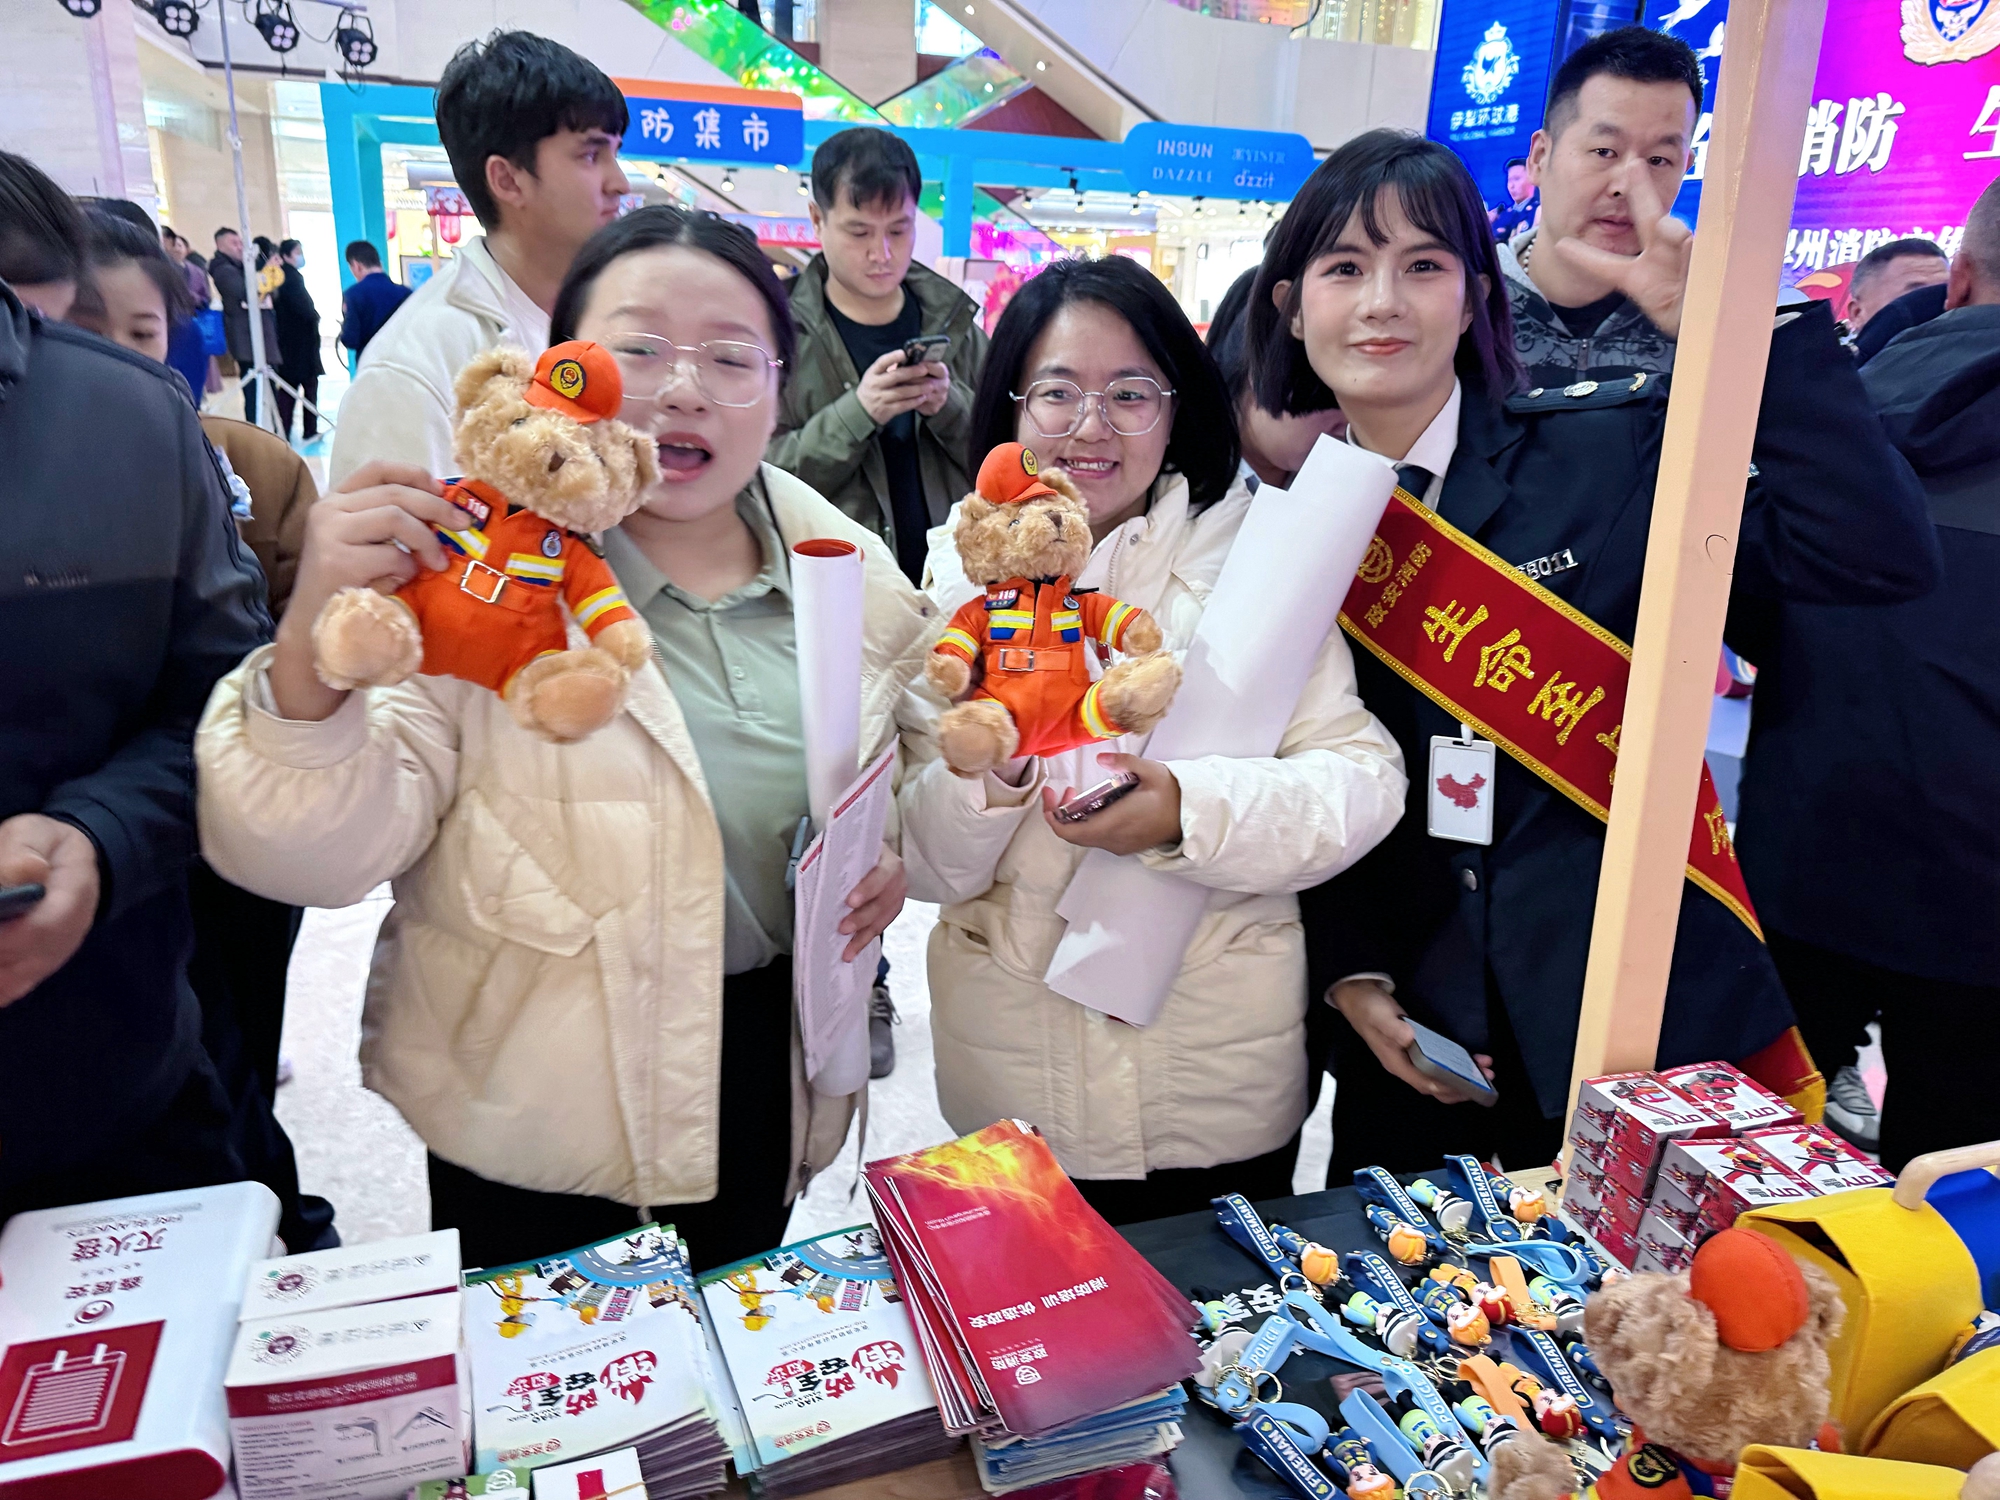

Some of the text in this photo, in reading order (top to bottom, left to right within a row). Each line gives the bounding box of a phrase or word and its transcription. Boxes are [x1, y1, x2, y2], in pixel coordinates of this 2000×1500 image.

[640, 107, 770, 152] 防集市
[1157, 139, 1214, 158] INSUN
[998, 588, 1016, 600] 119
[1364, 540, 1433, 629] 政安消防
[1381, 1175, 1419, 1217] FIREMAN
[1468, 1166, 1501, 1219] FIREMAN
[1238, 1204, 1275, 1252] FIREMAN
[967, 1276, 1109, 1329] 消防培训 优选政安
[1377, 1263, 1419, 1319] FIREMAN
[991, 1347, 1049, 1371] 政安消防
[1249, 1325, 1280, 1364] POLICE
[1540, 1340, 1583, 1399] FIREMAN
[1415, 1379, 1453, 1424] POLICE
[1268, 1429, 1322, 1488] FIREMAN
